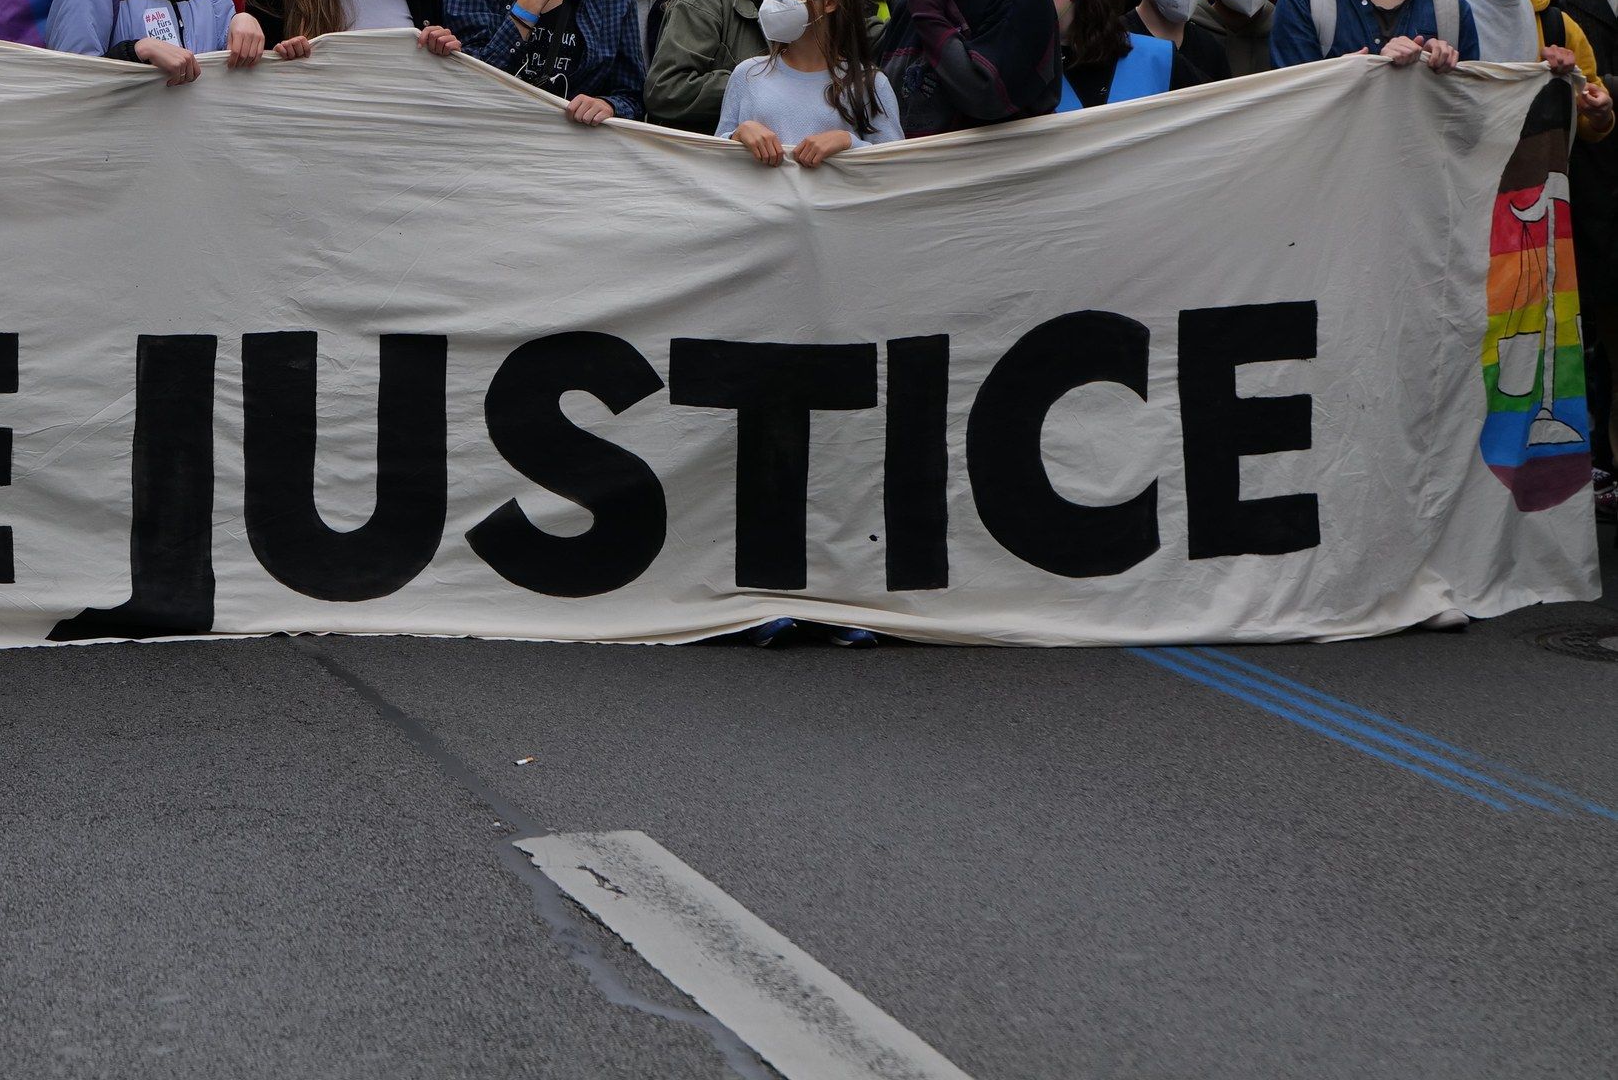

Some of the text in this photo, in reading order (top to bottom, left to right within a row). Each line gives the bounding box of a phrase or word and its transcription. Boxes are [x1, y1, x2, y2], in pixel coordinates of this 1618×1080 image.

[145, 12, 166, 23] #Alle
[157, 19, 172, 29] fürs
[148, 27, 170, 38] Klima
[45, 300, 1320, 641] JUSTICE
